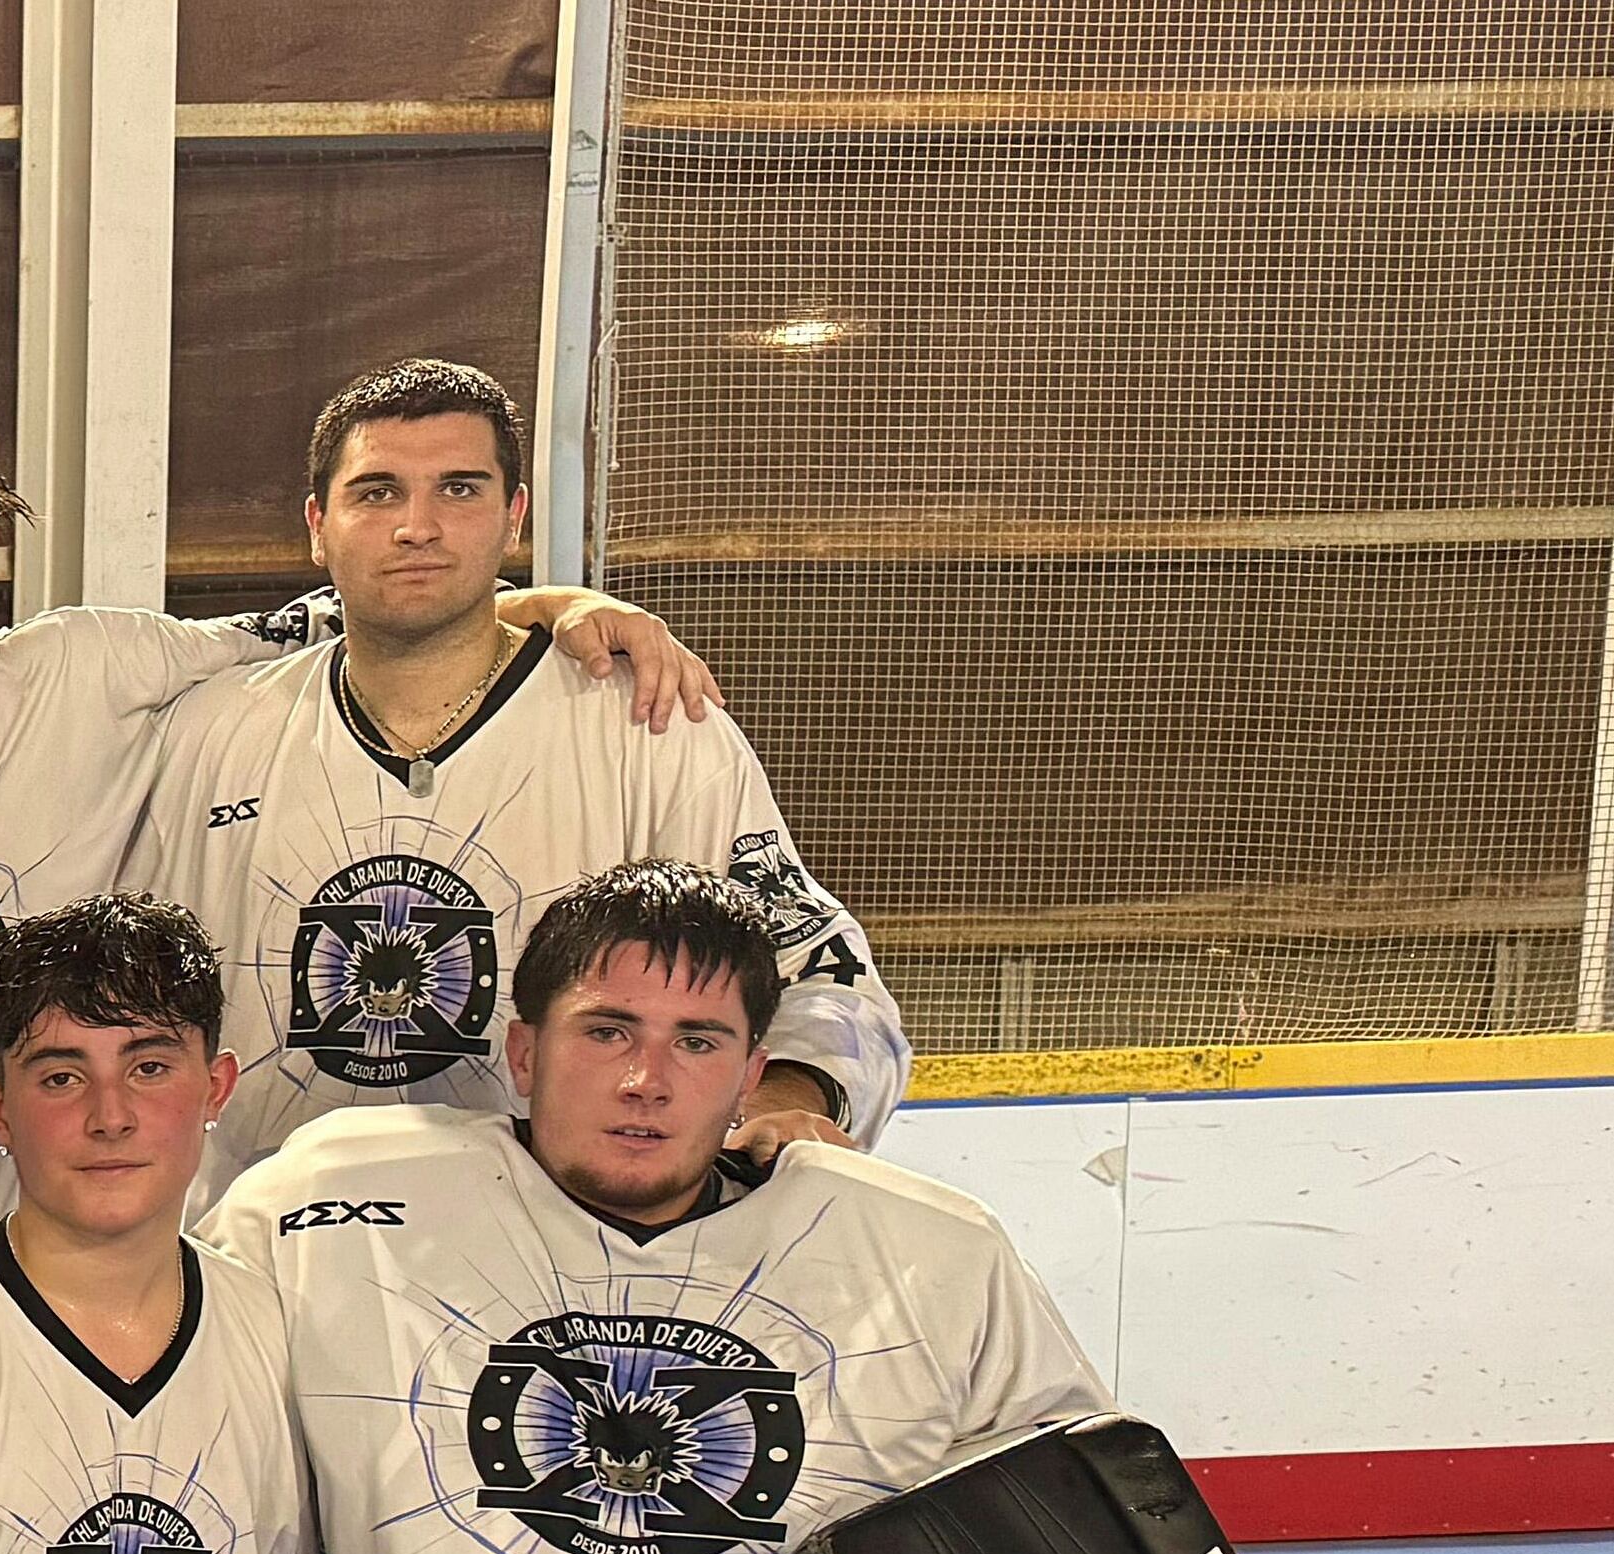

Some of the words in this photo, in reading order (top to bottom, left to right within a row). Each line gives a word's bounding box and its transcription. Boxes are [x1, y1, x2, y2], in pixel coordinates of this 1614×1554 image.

[207, 797, 260, 829] EXS
[319, 878, 350, 906] CHL
[349, 861, 403, 891] ARANDA
[407, 864, 426, 886] DE
[426, 871, 476, 908] DUERO
[344, 1060, 376, 1081] DESDE
[377, 1061, 409, 1081] 2010
[280, 1200, 406, 1238] REXS
[565, 1317, 646, 1346] ARANDA
[651, 1321, 678, 1348] DE
[680, 1328, 756, 1369] DUERO
[68, 1519, 94, 1544] CHL
